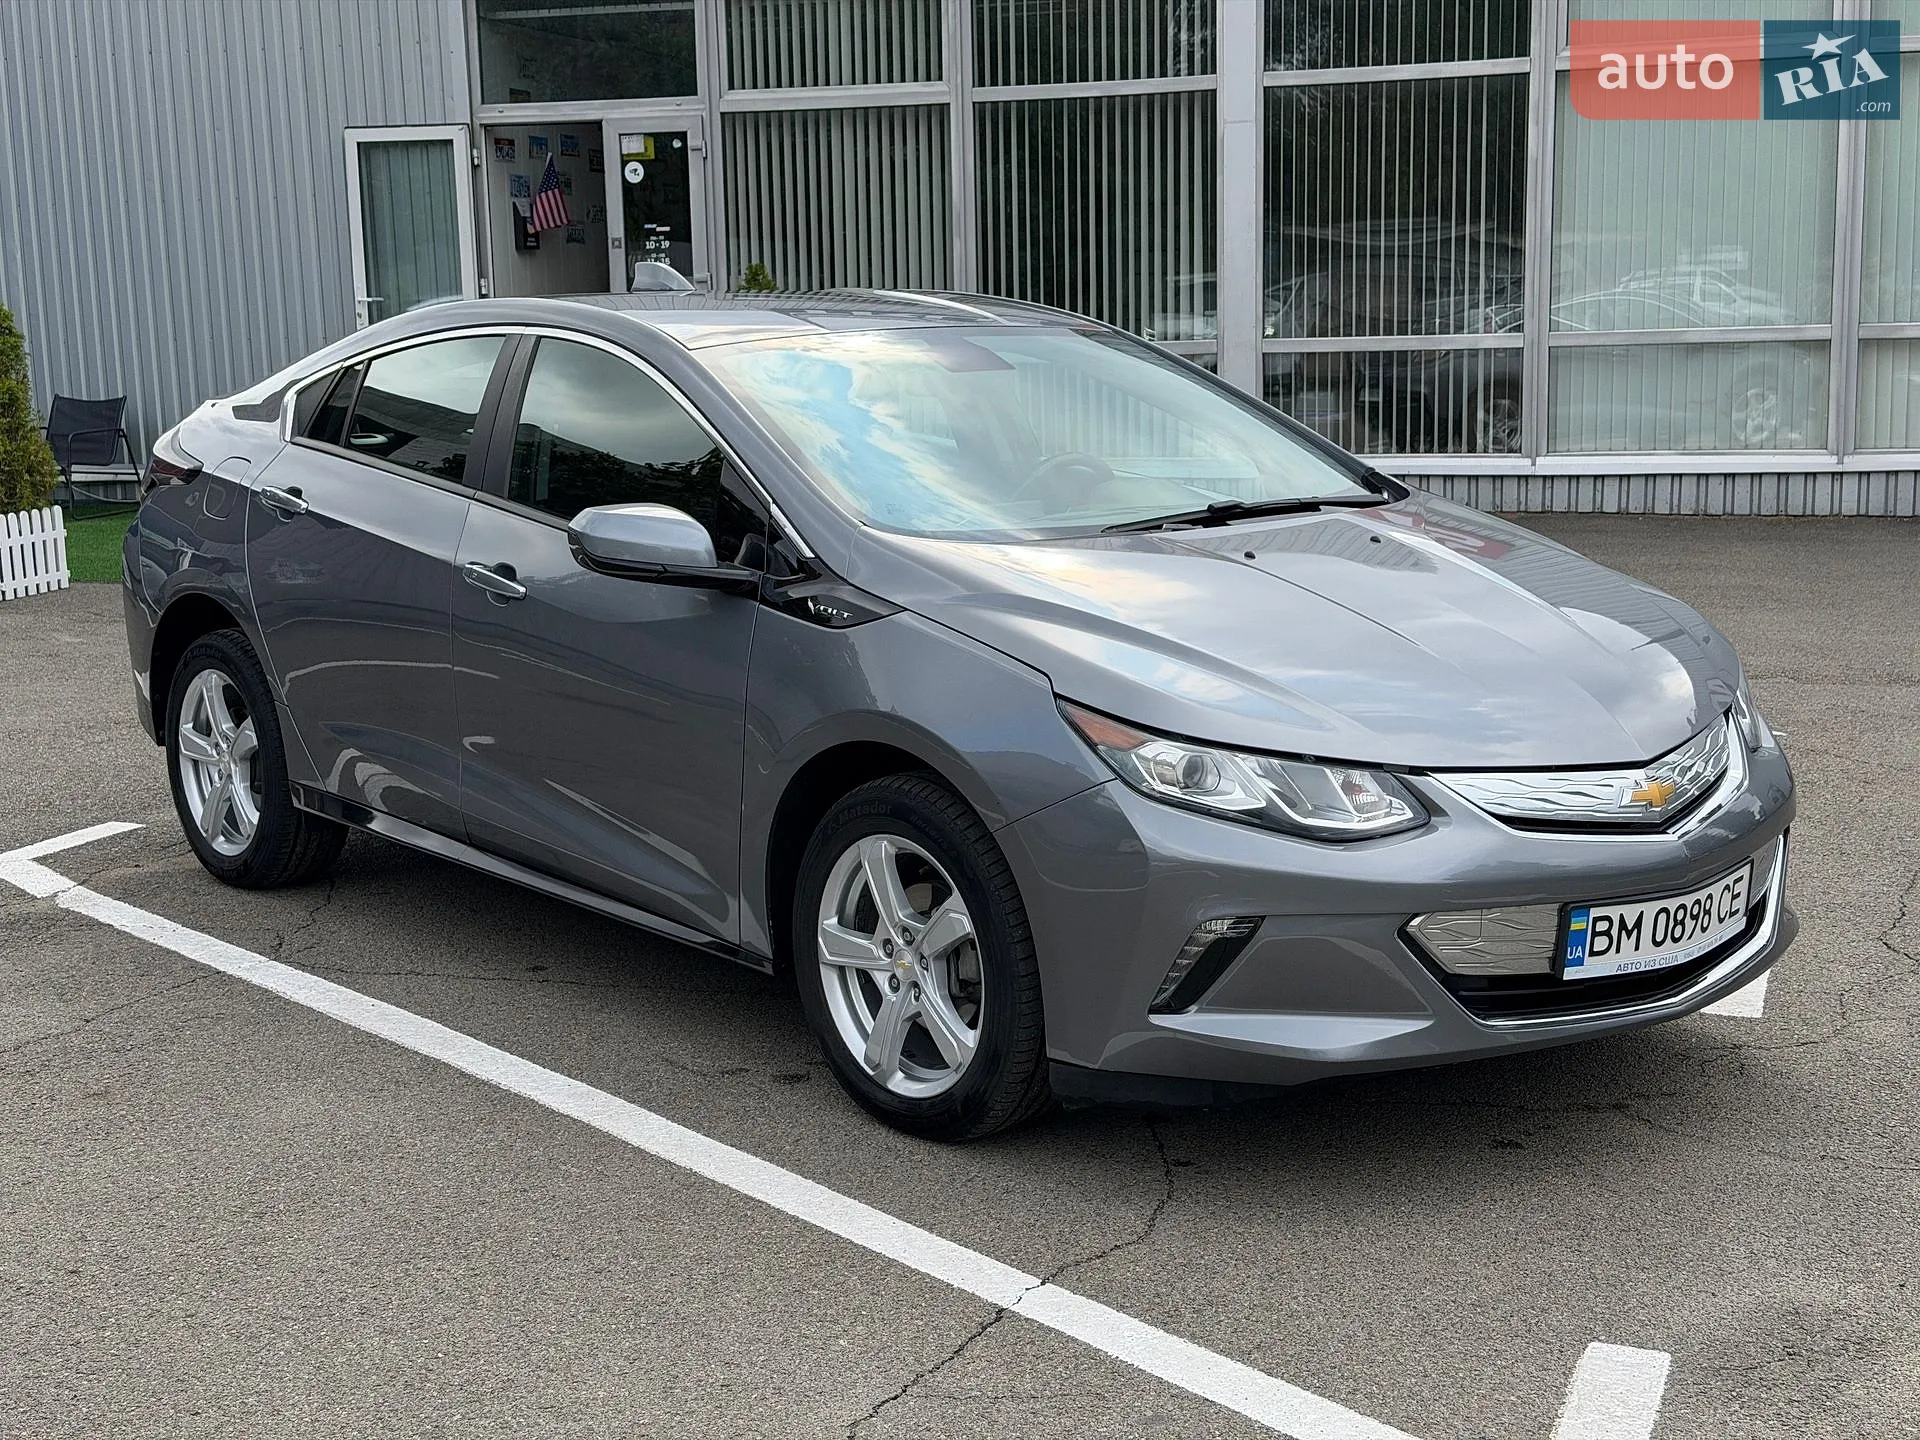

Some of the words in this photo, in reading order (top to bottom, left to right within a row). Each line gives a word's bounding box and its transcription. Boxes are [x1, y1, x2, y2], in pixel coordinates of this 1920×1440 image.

[807, 598, 853, 621] VOLT
[839, 800, 893, 825] Matador
[1588, 911, 1645, 958] BM
[1652, 892, 1713, 948] 0898
[1717, 874, 1745, 925] CE
[1567, 946, 1583, 960] UA
[1615, 961, 1642, 974] АВТО
[1644, 959, 1657, 969] ИЗ
[1658, 954, 1679, 967] США
